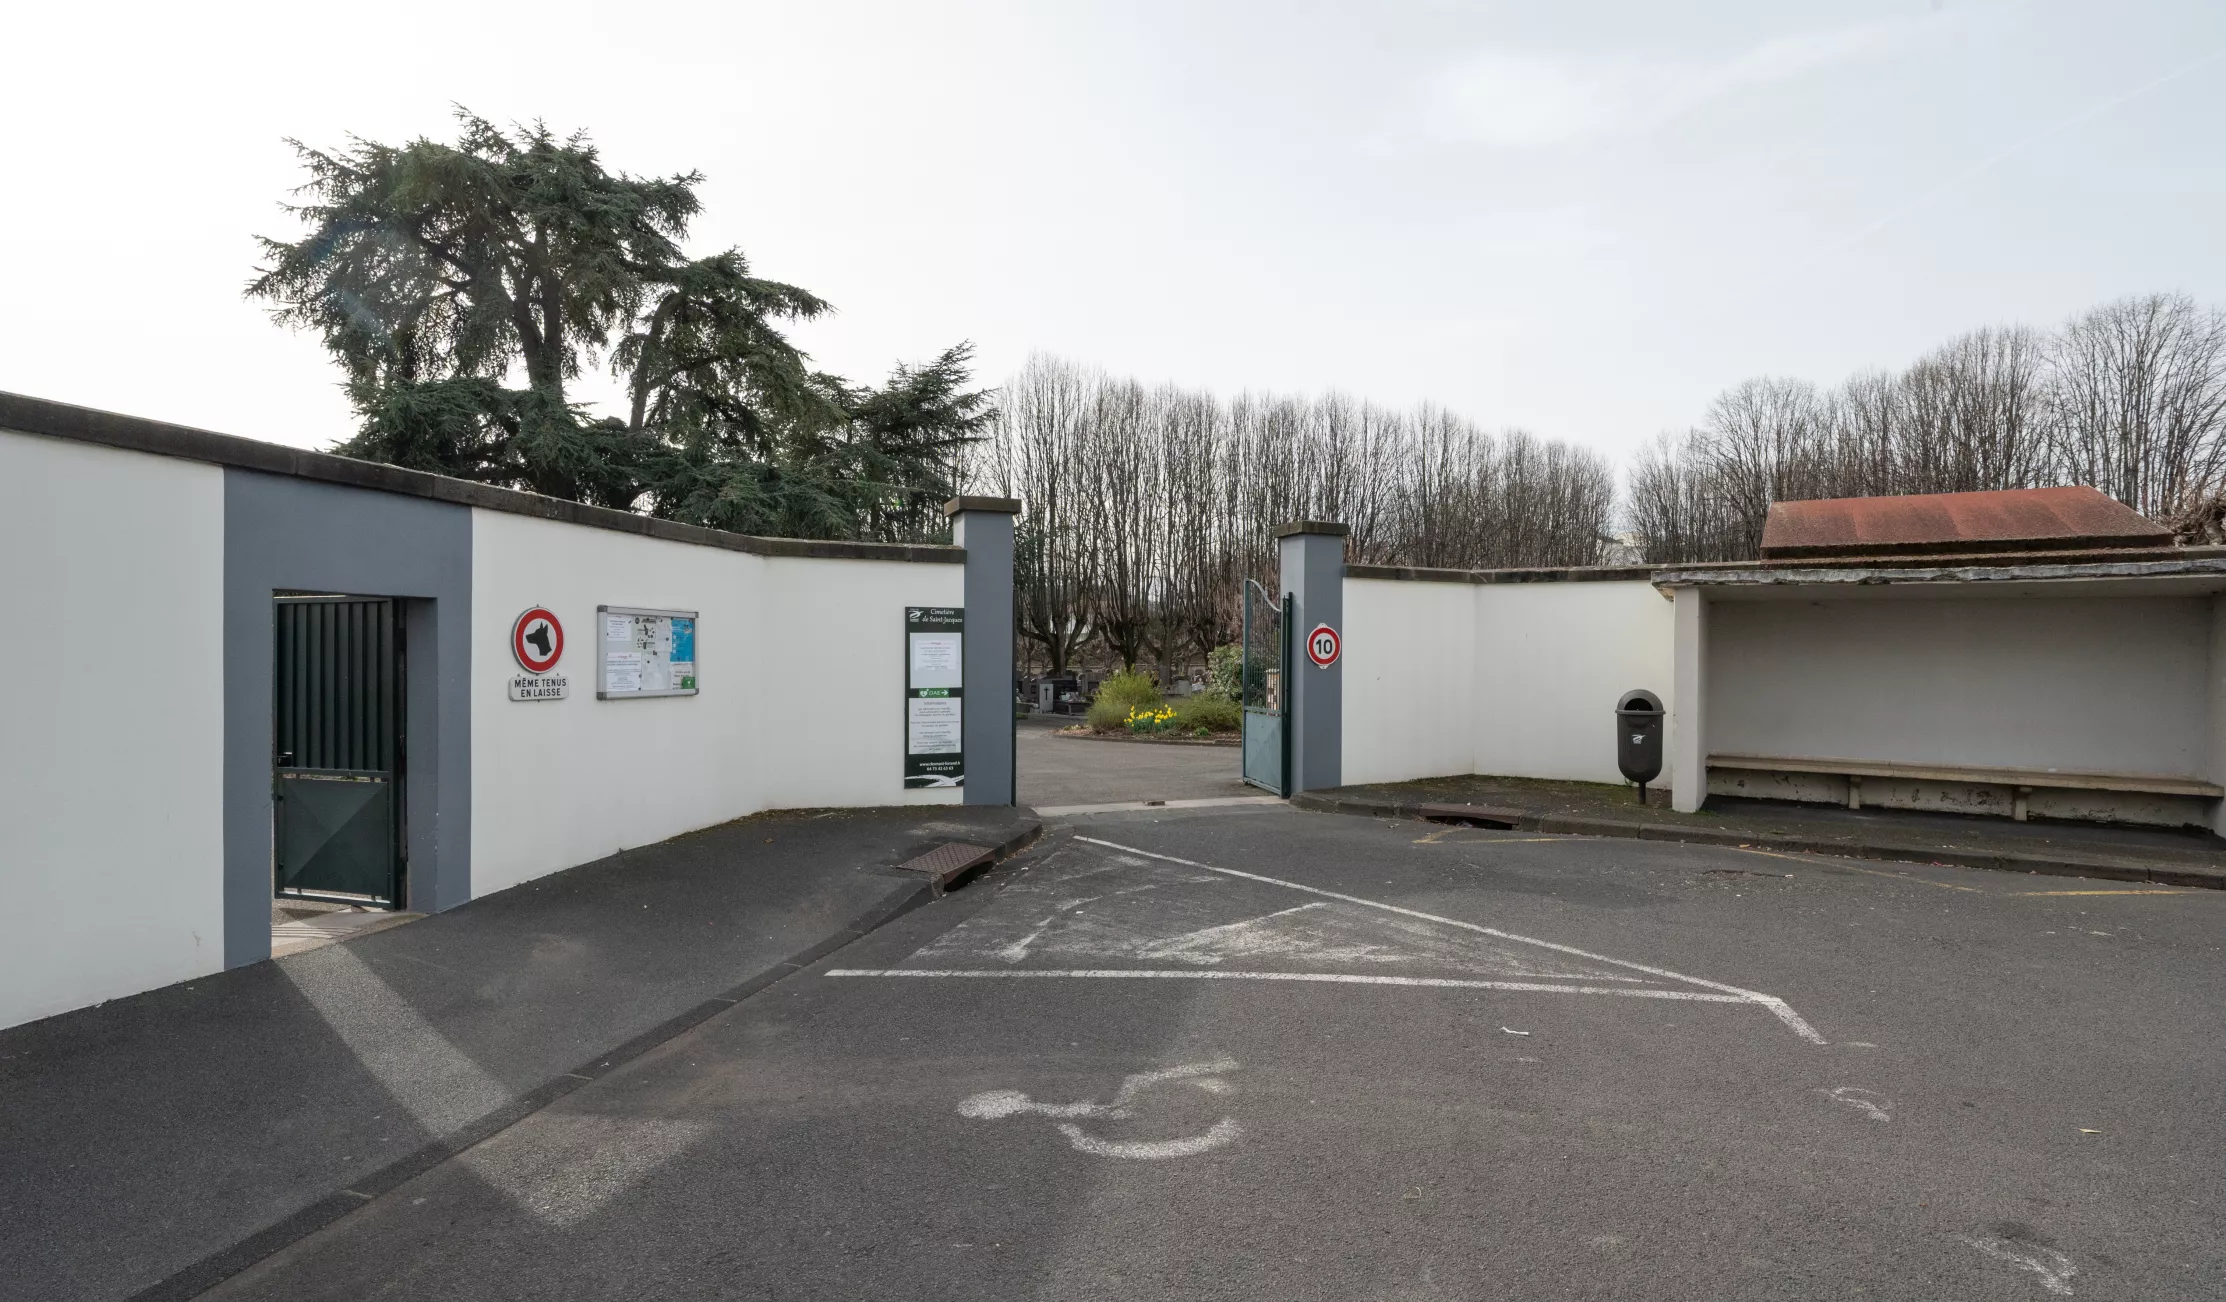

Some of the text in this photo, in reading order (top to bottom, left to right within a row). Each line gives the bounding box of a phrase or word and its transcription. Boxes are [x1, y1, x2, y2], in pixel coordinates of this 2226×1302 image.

[1315, 639, 1333, 655] 10
[514, 678, 567, 688] MÊME TENUS
[520, 688, 561, 698] EN LAISSE
